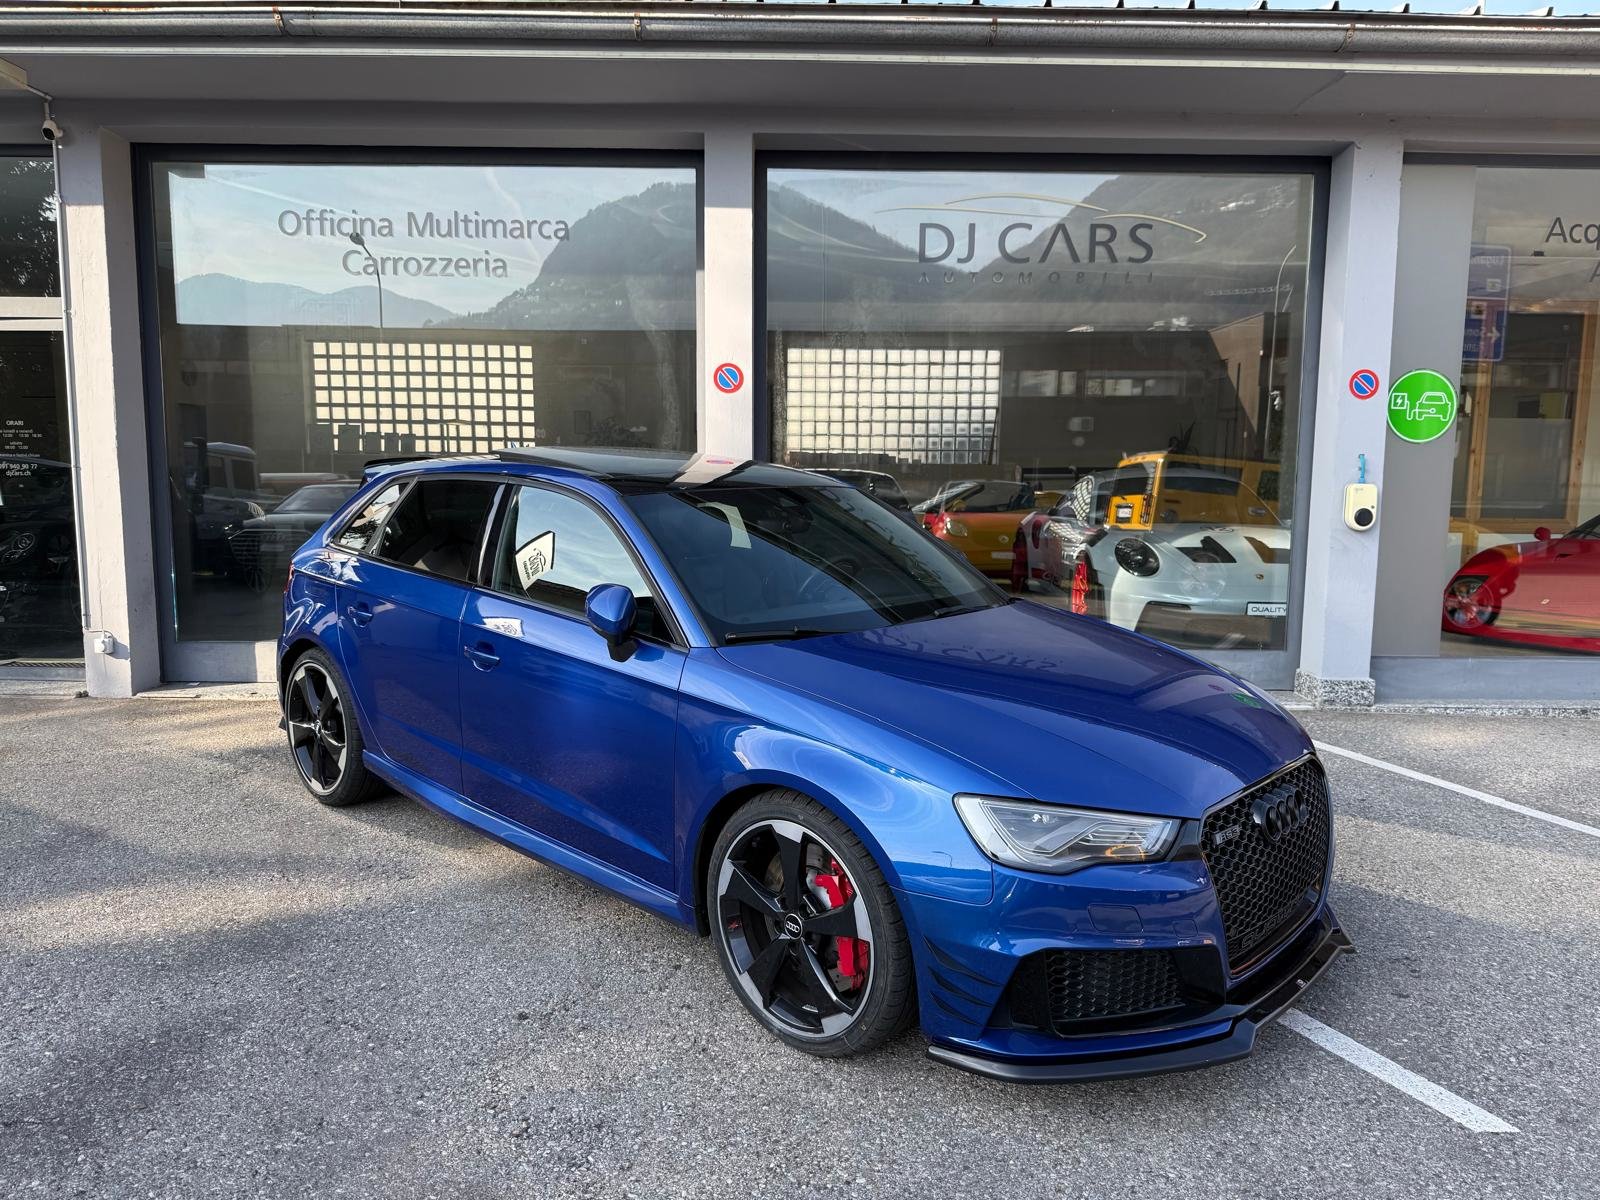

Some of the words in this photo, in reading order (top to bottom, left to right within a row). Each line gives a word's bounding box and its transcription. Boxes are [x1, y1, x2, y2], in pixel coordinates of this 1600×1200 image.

[278, 209, 394, 237] Officina
[407, 210, 571, 241] Multimarca
[919, 223, 976, 263] DJ
[998, 223, 1154, 264] CARS
[342, 249, 508, 278] Carrozzeria
[918, 271, 1154, 284] AUTOMOBILI
